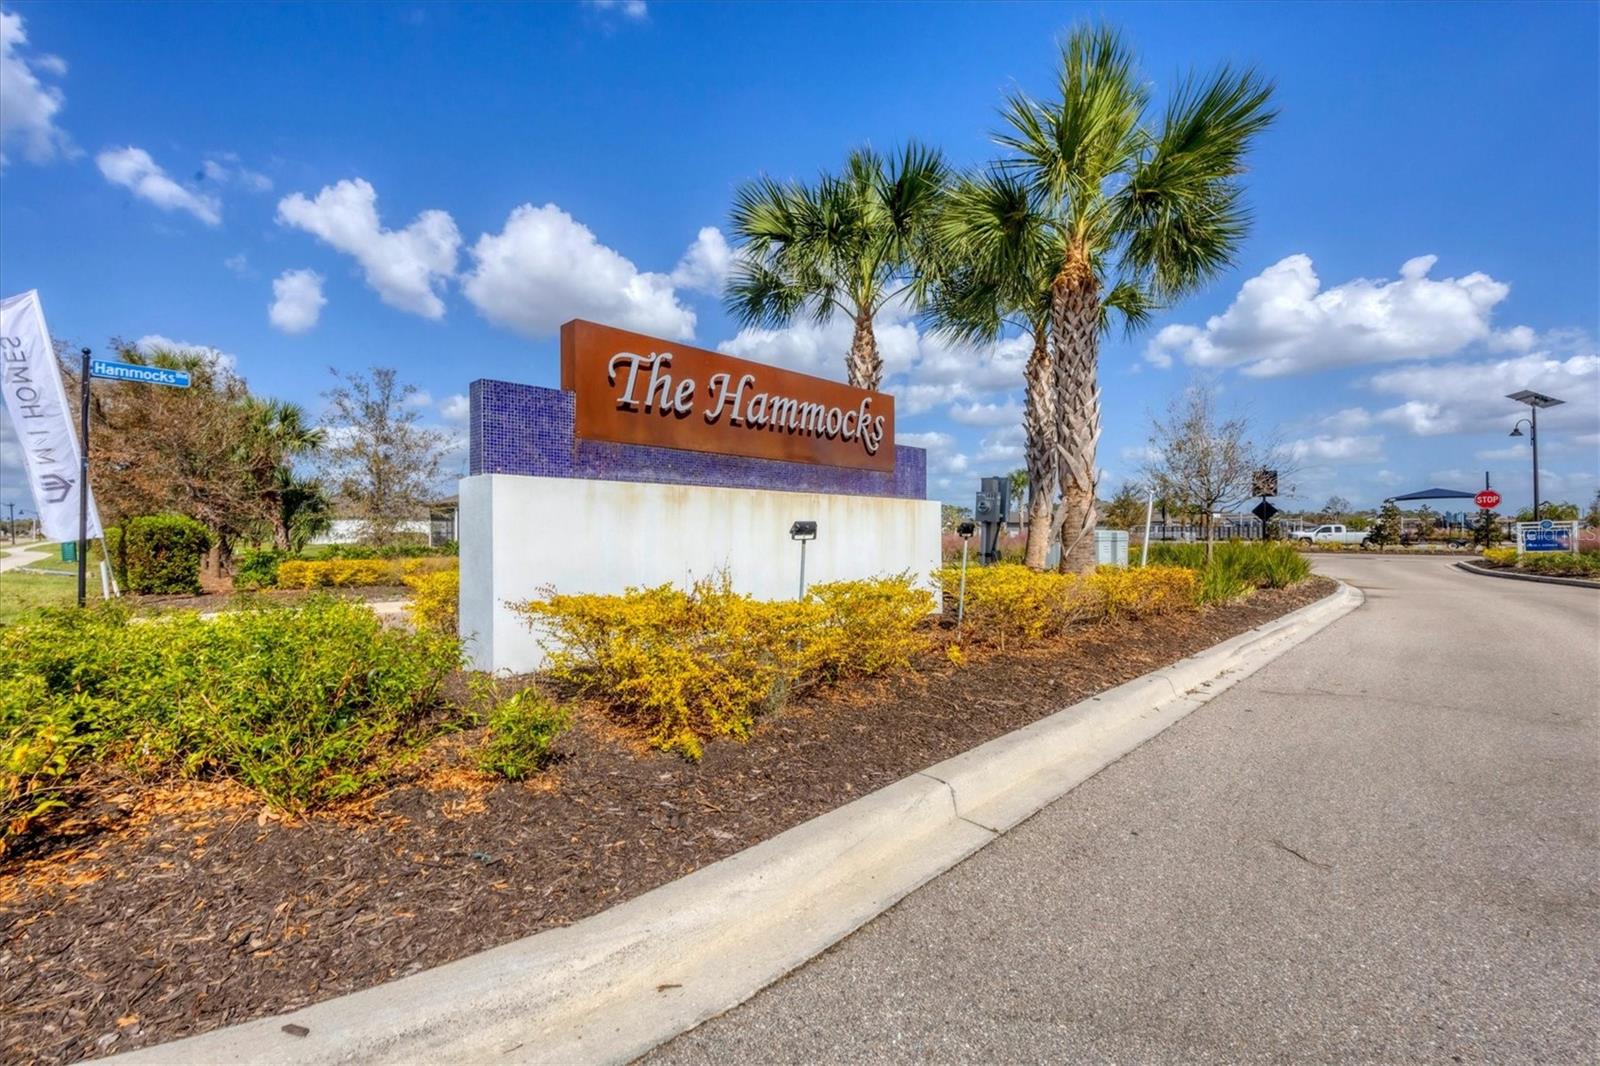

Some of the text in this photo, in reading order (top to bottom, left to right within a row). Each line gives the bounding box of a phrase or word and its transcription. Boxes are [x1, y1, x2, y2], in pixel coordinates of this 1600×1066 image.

[94, 361, 176, 384] Hammocks
[608, 352, 885, 453] The Hammocks
[1476, 495, 1499, 503] STOP
